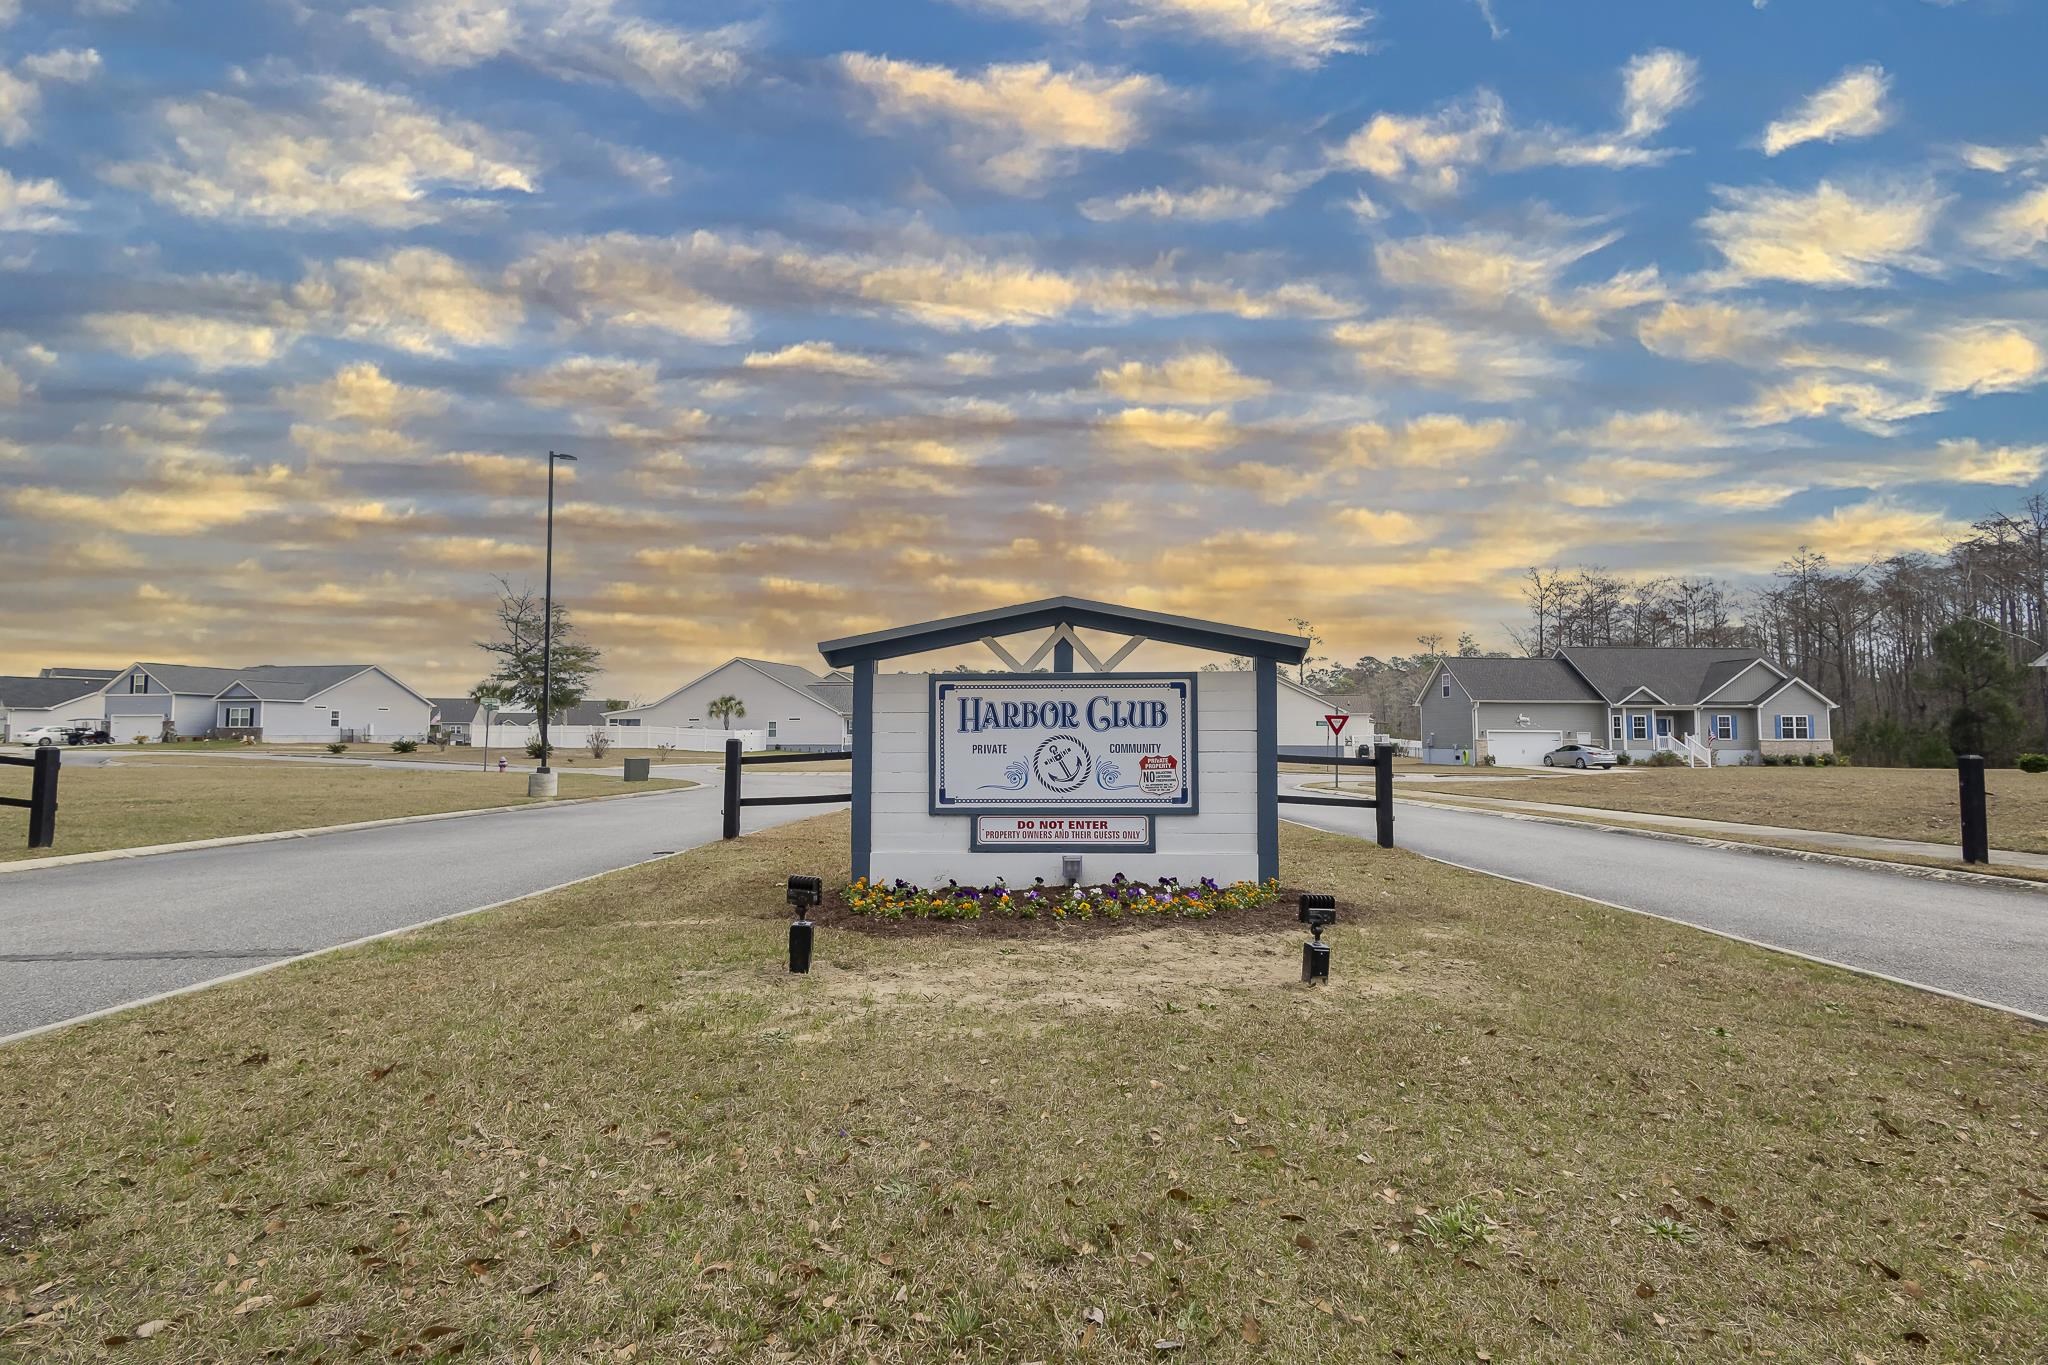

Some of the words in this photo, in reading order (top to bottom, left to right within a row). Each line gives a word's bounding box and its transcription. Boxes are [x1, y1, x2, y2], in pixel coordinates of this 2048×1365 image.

[957, 697, 1080, 733] HARBOR
[1085, 695, 1169, 732] CLUB
[972, 744, 1008, 754] PRIVATE
[1109, 743, 1161, 754] COMMUNITY
[1143, 771, 1155, 783] NO
[1017, 820, 1035, 830] DO
[1039, 820, 1065, 830] NOT
[1068, 820, 1108, 830] ENTER
[985, 830, 1021, 840] PROPERTY
[1022, 830, 1053, 840] OWNERS
[1054, 830, 1071, 839] AND
[1071, 830, 1092, 839] THEIR
[1093, 830, 1120, 839] GUESTS
[1122, 830, 1141, 839] ONLY
